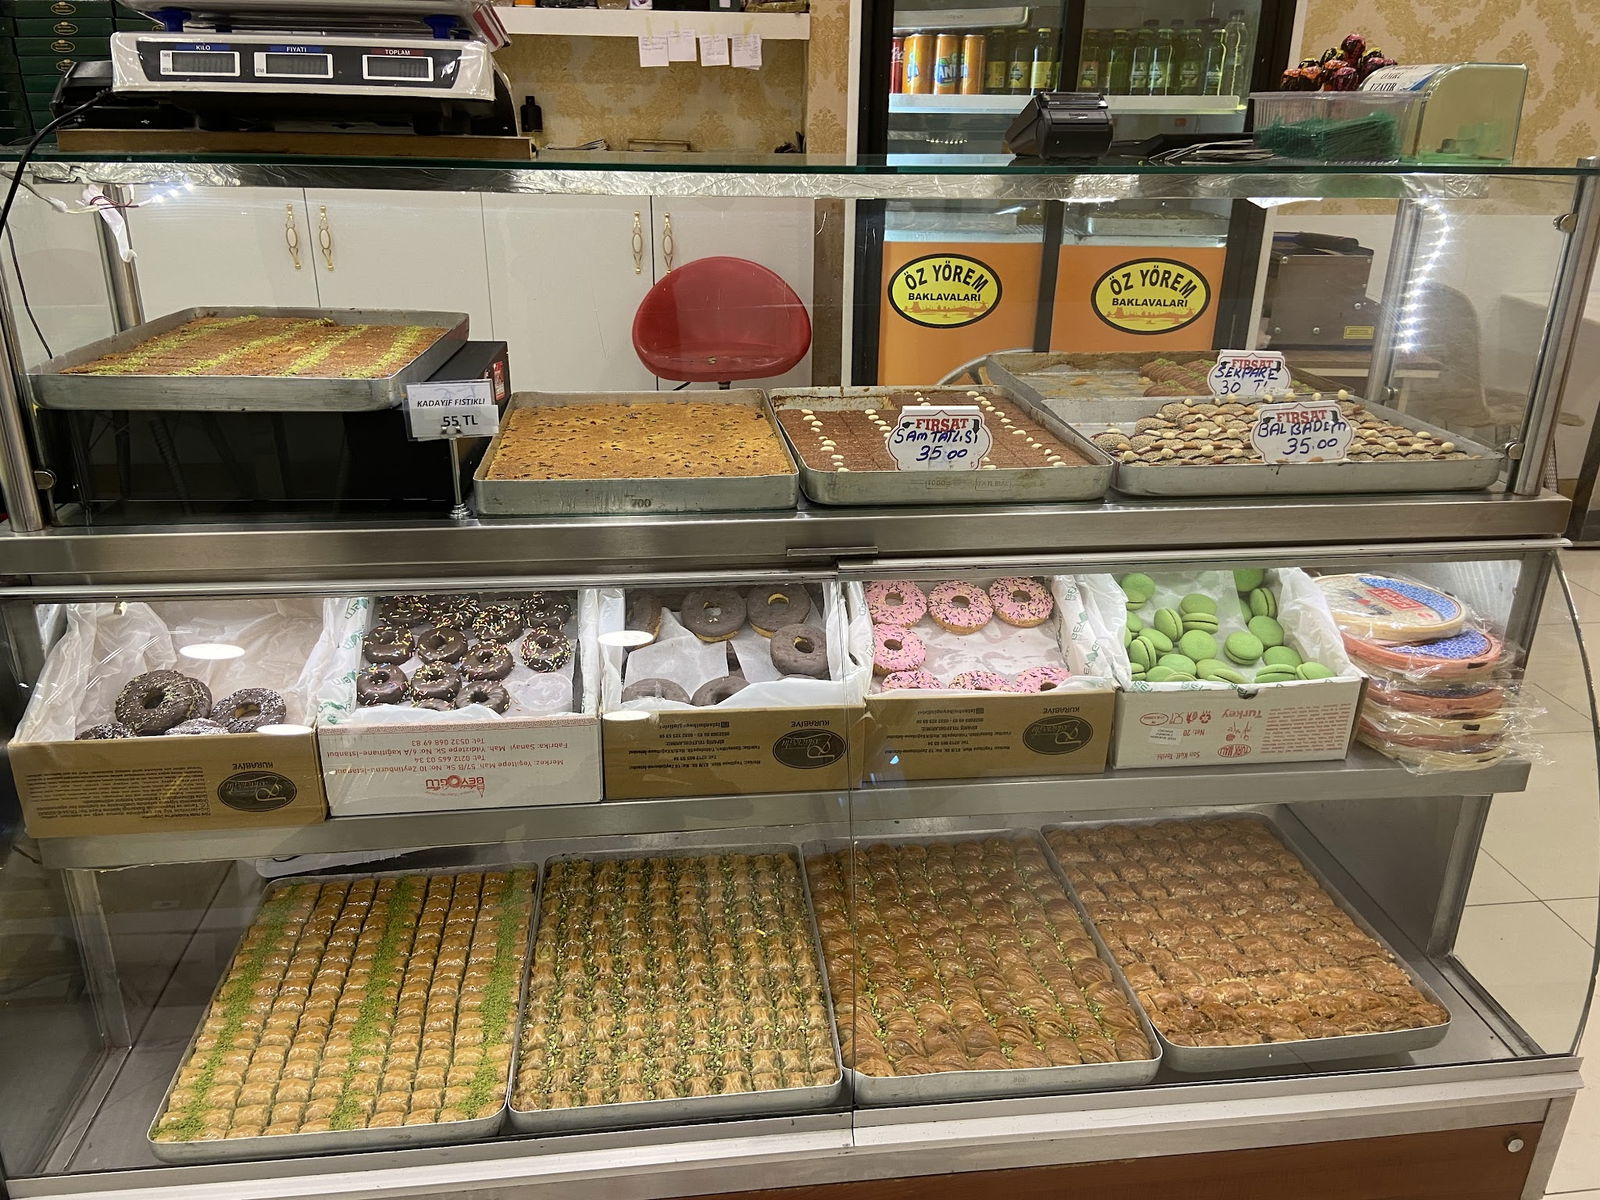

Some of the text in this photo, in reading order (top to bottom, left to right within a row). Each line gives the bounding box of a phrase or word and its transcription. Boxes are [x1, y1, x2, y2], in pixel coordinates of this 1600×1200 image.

[903, 260, 989, 293] ÖZ YÖREM
[1109, 264, 1198, 299] ÖZ YÖREM
[1112, 298, 1188, 307] BAKLAVALARI
[1220, 380, 1241, 395] 30
[462, 415, 479, 426] TL
[1275, 410, 1327, 425] FIRSAT
[915, 418, 969, 432] FIRSAT
[1257, 422, 1287, 437] BAL
[894, 428, 928, 444] SAM
[631, 498, 652, 508] 700
[1222, 709, 1262, 720] Turkey
[791, 720, 831, 728] KURABİYE
[1183, 729, 1191, 737] 20
[509, 743, 535, 751] Sanayi
[1189, 751, 1201, 759] Son
[232, 761, 274, 770] KURABİYE
